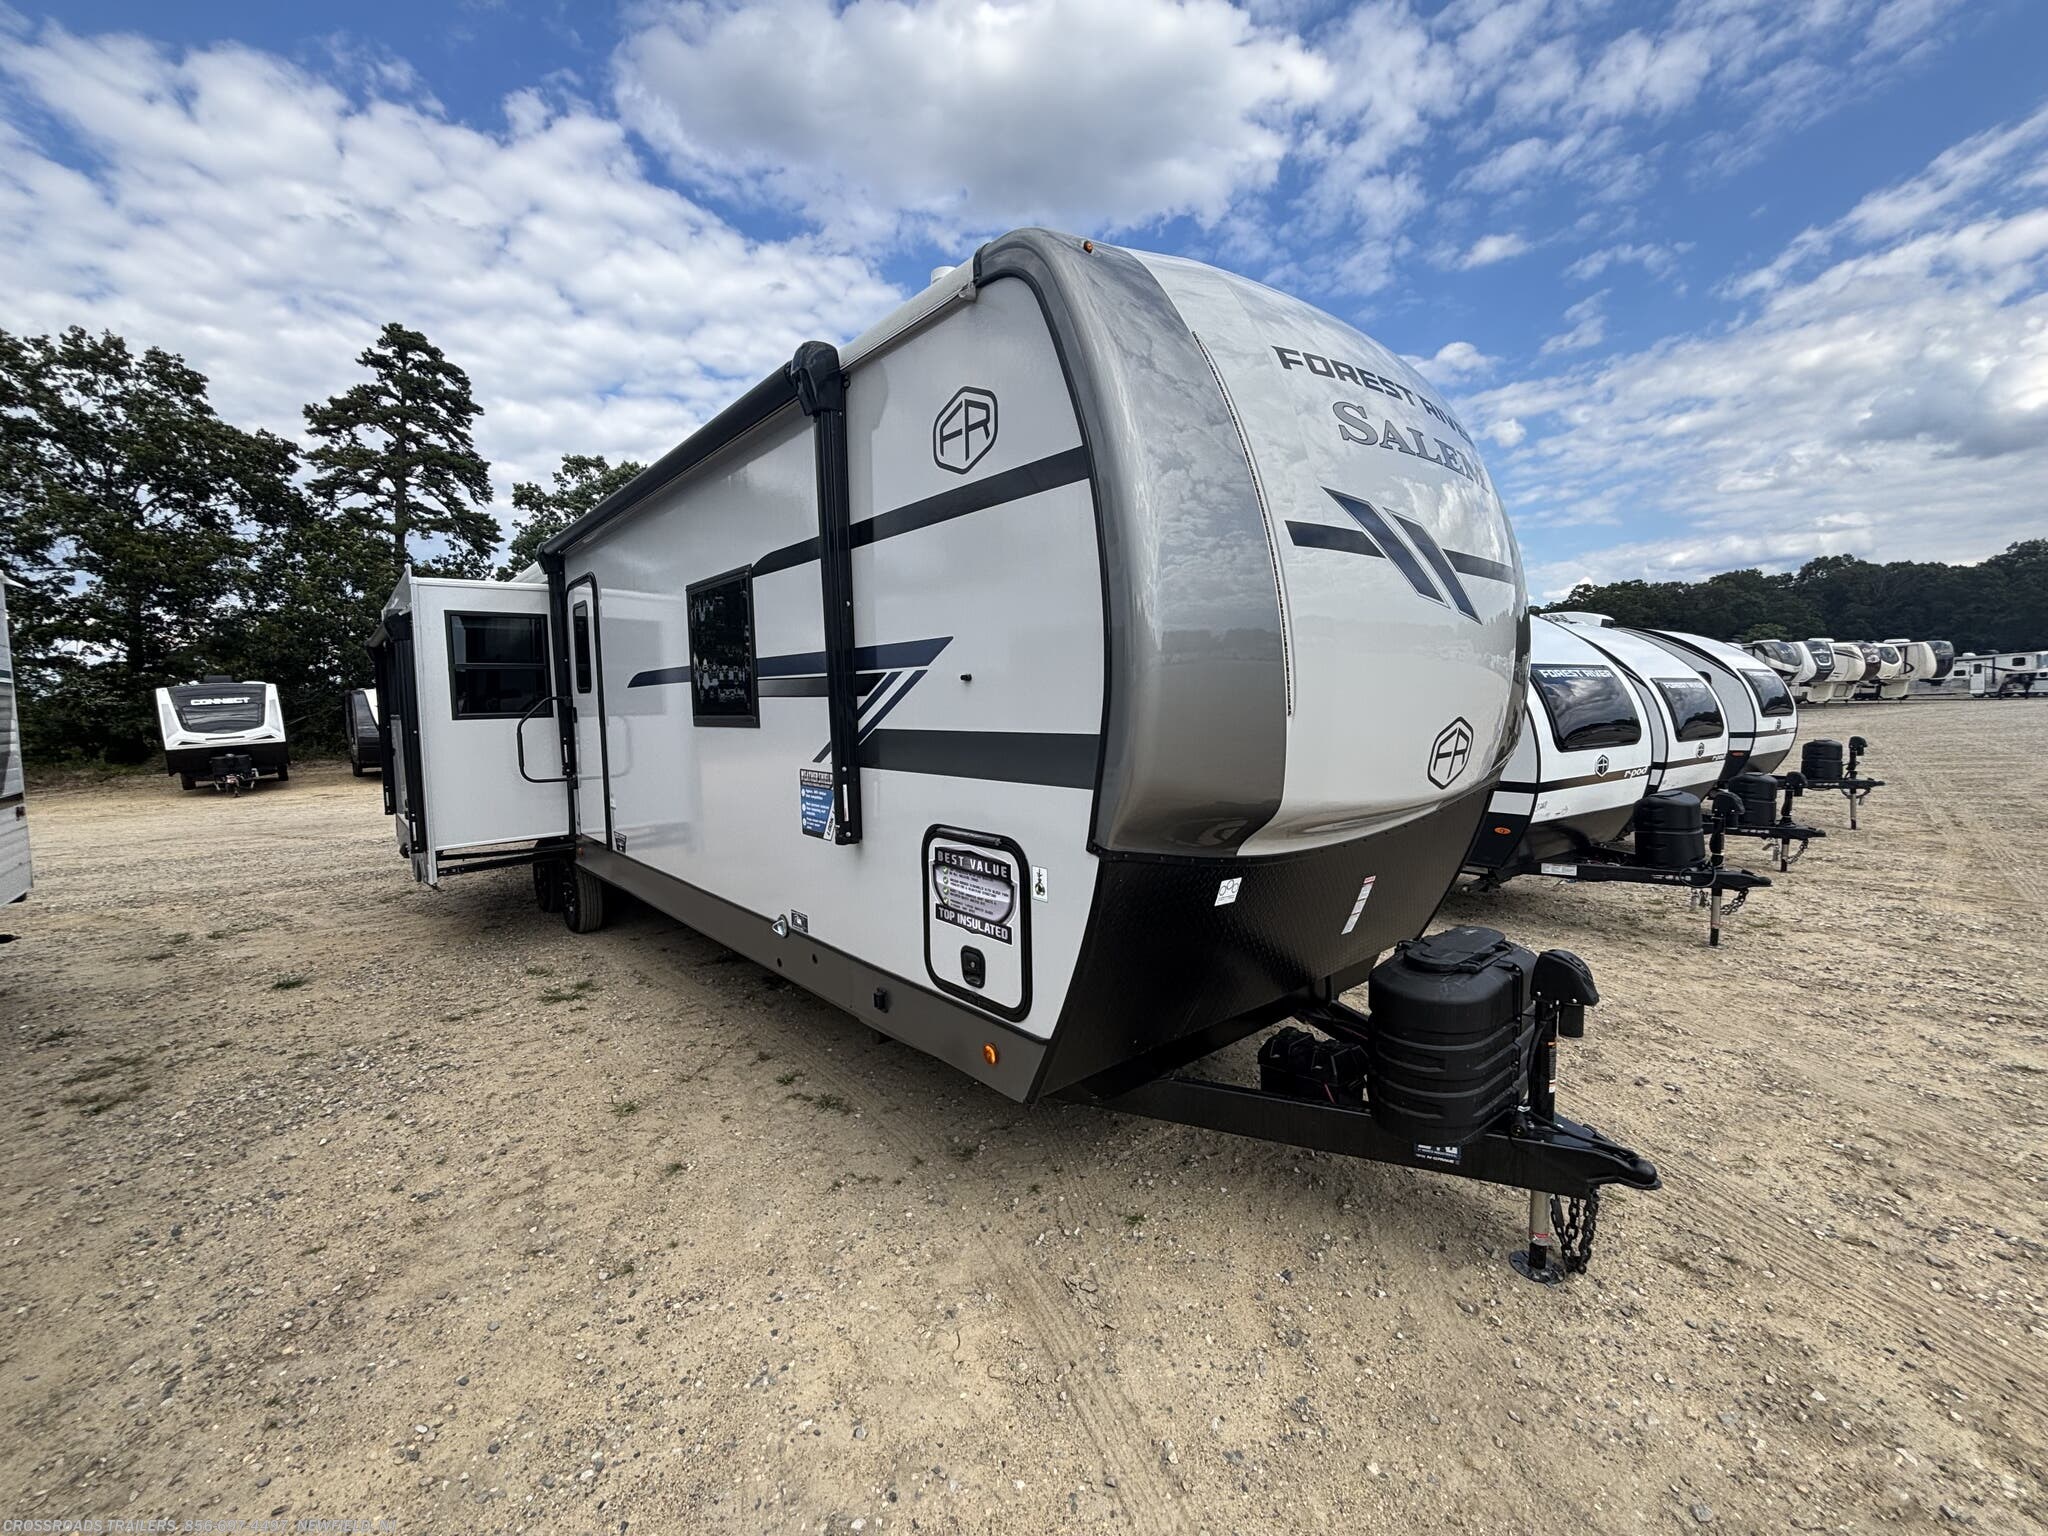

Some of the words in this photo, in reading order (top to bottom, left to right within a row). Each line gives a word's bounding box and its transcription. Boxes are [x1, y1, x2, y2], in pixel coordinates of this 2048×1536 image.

[1271, 345, 1415, 407] FOREST
[1416, 393, 1476, 449] RIVE
[1332, 401, 1490, 494] SALEM
[1540, 669, 1583, 678] FOREST
[190, 697, 251, 706] CONNECT
[937, 850, 965, 868] BEST
[969, 858, 1008, 878] VALUE
[938, 906, 956, 922] TOP
[956, 912, 1009, 941] INSULATED
